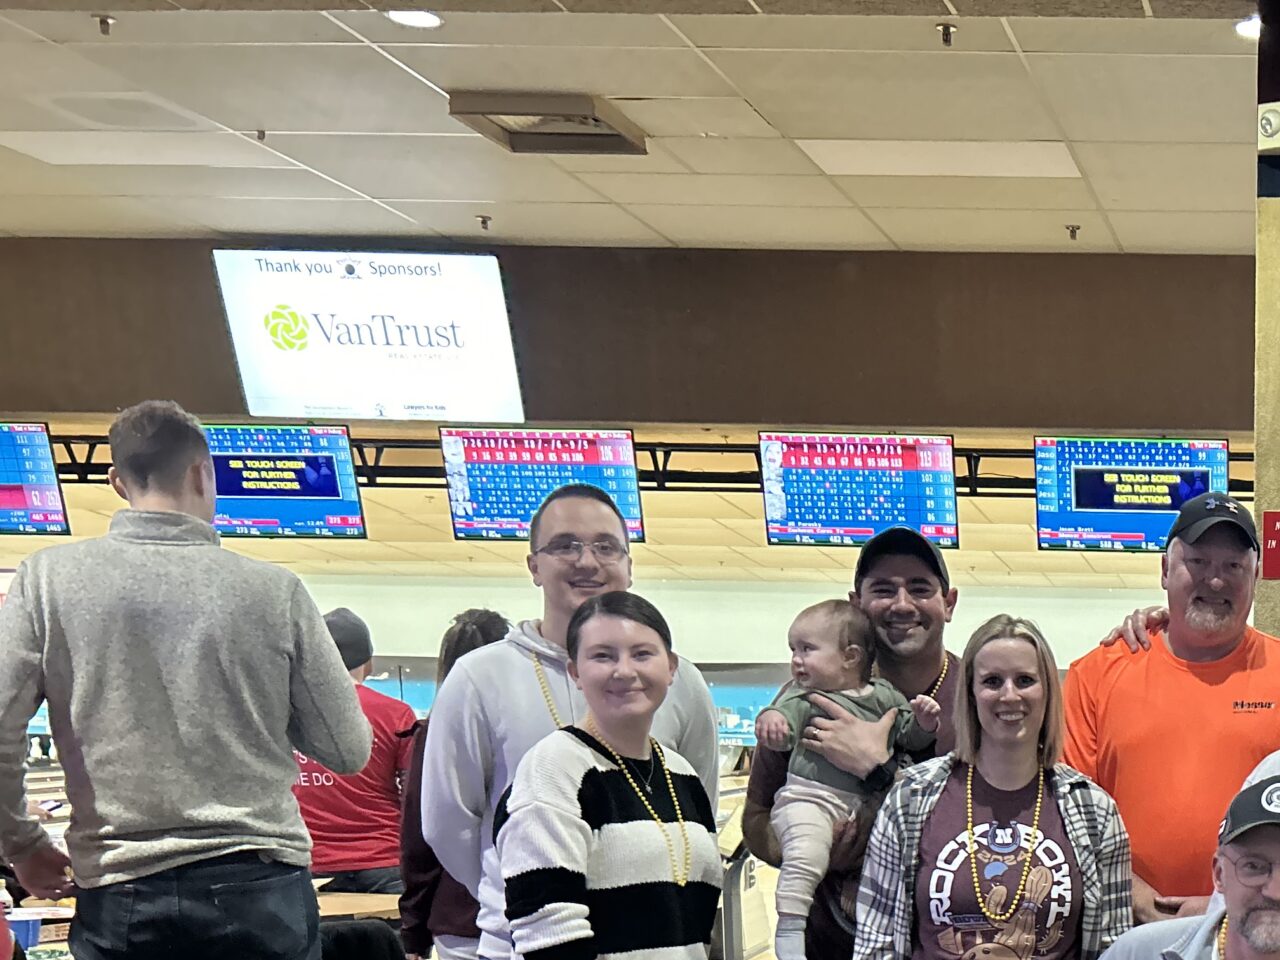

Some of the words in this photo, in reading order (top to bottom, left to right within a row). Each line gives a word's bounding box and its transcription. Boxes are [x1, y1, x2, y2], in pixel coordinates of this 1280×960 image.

[255, 258, 300, 273] Thank
[306, 262, 332, 279] you
[369, 261, 441, 278] Sponsors!
[312, 314, 464, 348] VanTrust
[1104, 474, 1118, 482] SEE
[1120, 474, 1149, 482] TOUCH
[1151, 474, 1181, 482] SCREEN
[242, 481, 300, 490] INSTRUCTIONS
[1116, 484, 1132, 492] FOR
[1134, 485, 1168, 494] FURTHER
[1114, 495, 1172, 504] INSTRUCTIONS
[1038, 504, 1055, 512] Izzy
[1268, 540, 1276, 548] IN
[1018, 823, 1072, 928] BOWL
